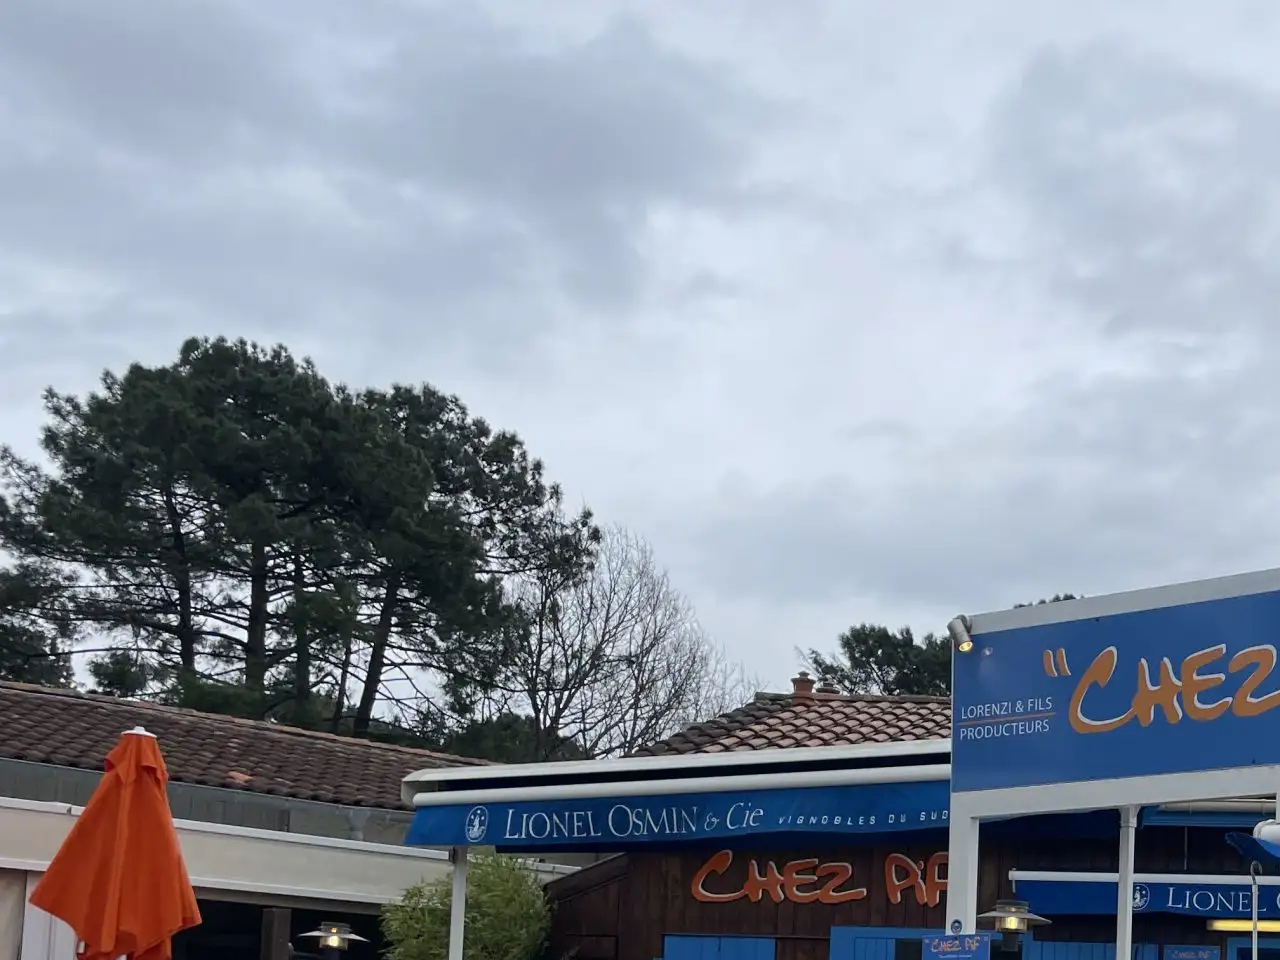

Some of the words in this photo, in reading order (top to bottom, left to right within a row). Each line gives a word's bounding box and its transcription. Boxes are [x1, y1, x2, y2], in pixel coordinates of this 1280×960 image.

[961, 702, 1012, 719] LORENZI
[1015, 701, 1024, 712] &
[1027, 697, 1052, 711] FILS
[959, 718, 1050, 740] PRODUCTEURS
[504, 809, 602, 839] LIONEL
[608, 804, 698, 837] OSMIN
[704, 812, 720, 831] &
[726, 802, 764, 830] Cie
[778, 815, 876, 825] VIGNOBLES
[919, 810, 948, 821] SUD
[691, 849, 867, 904] CHEZ
